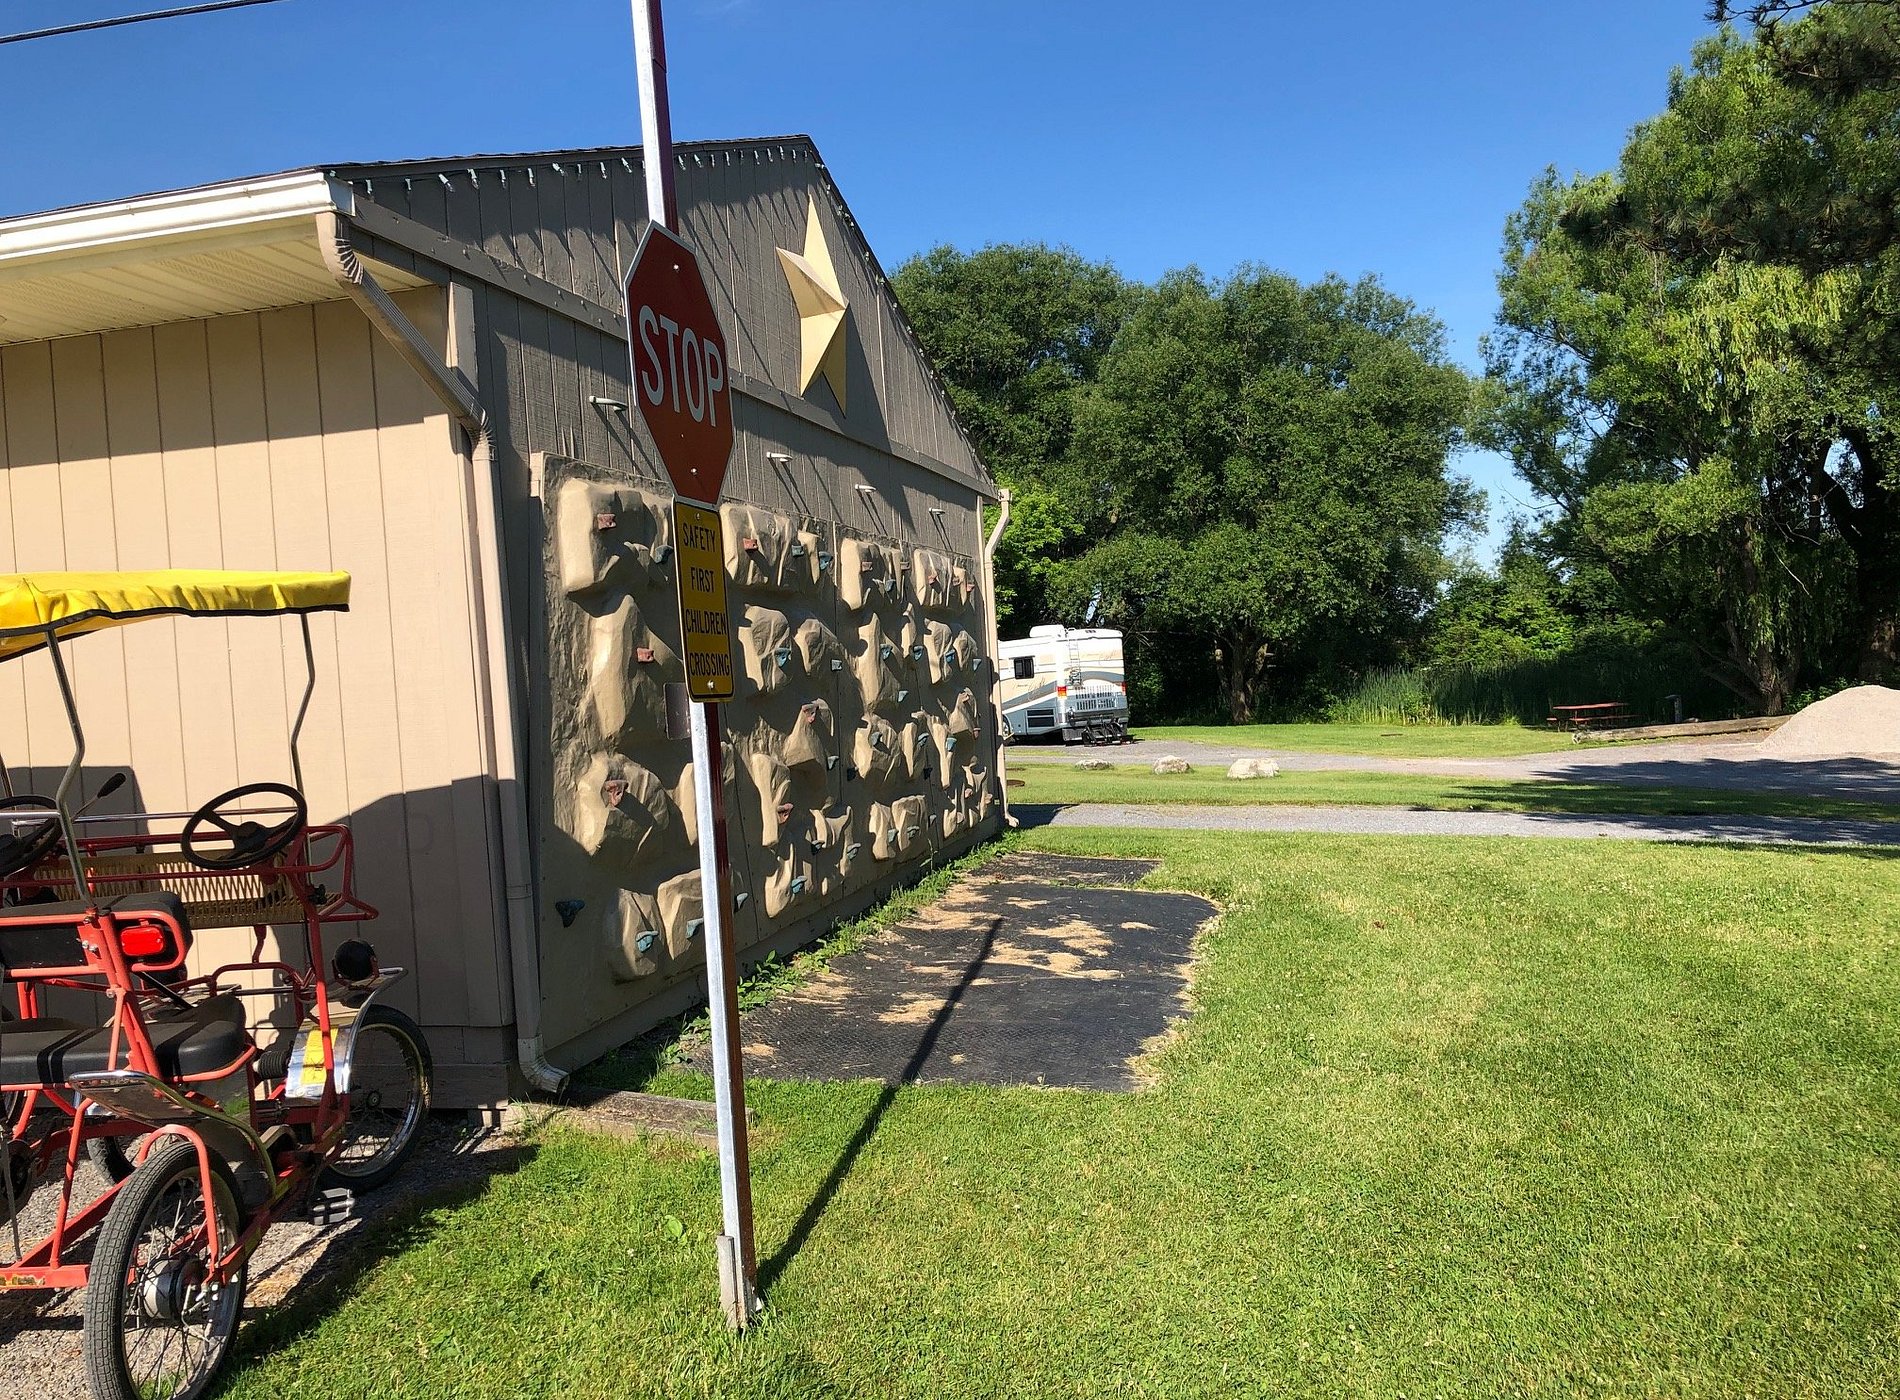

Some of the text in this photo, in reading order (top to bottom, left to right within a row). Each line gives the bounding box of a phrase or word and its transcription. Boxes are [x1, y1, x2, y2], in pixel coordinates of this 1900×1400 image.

[639, 305, 724, 427] STOP
[682, 522, 716, 553] SAFETY
[690, 566, 715, 593] FIRST
[685, 608, 727, 636] CHILDREN
[688, 652, 731, 676] CROSSING
